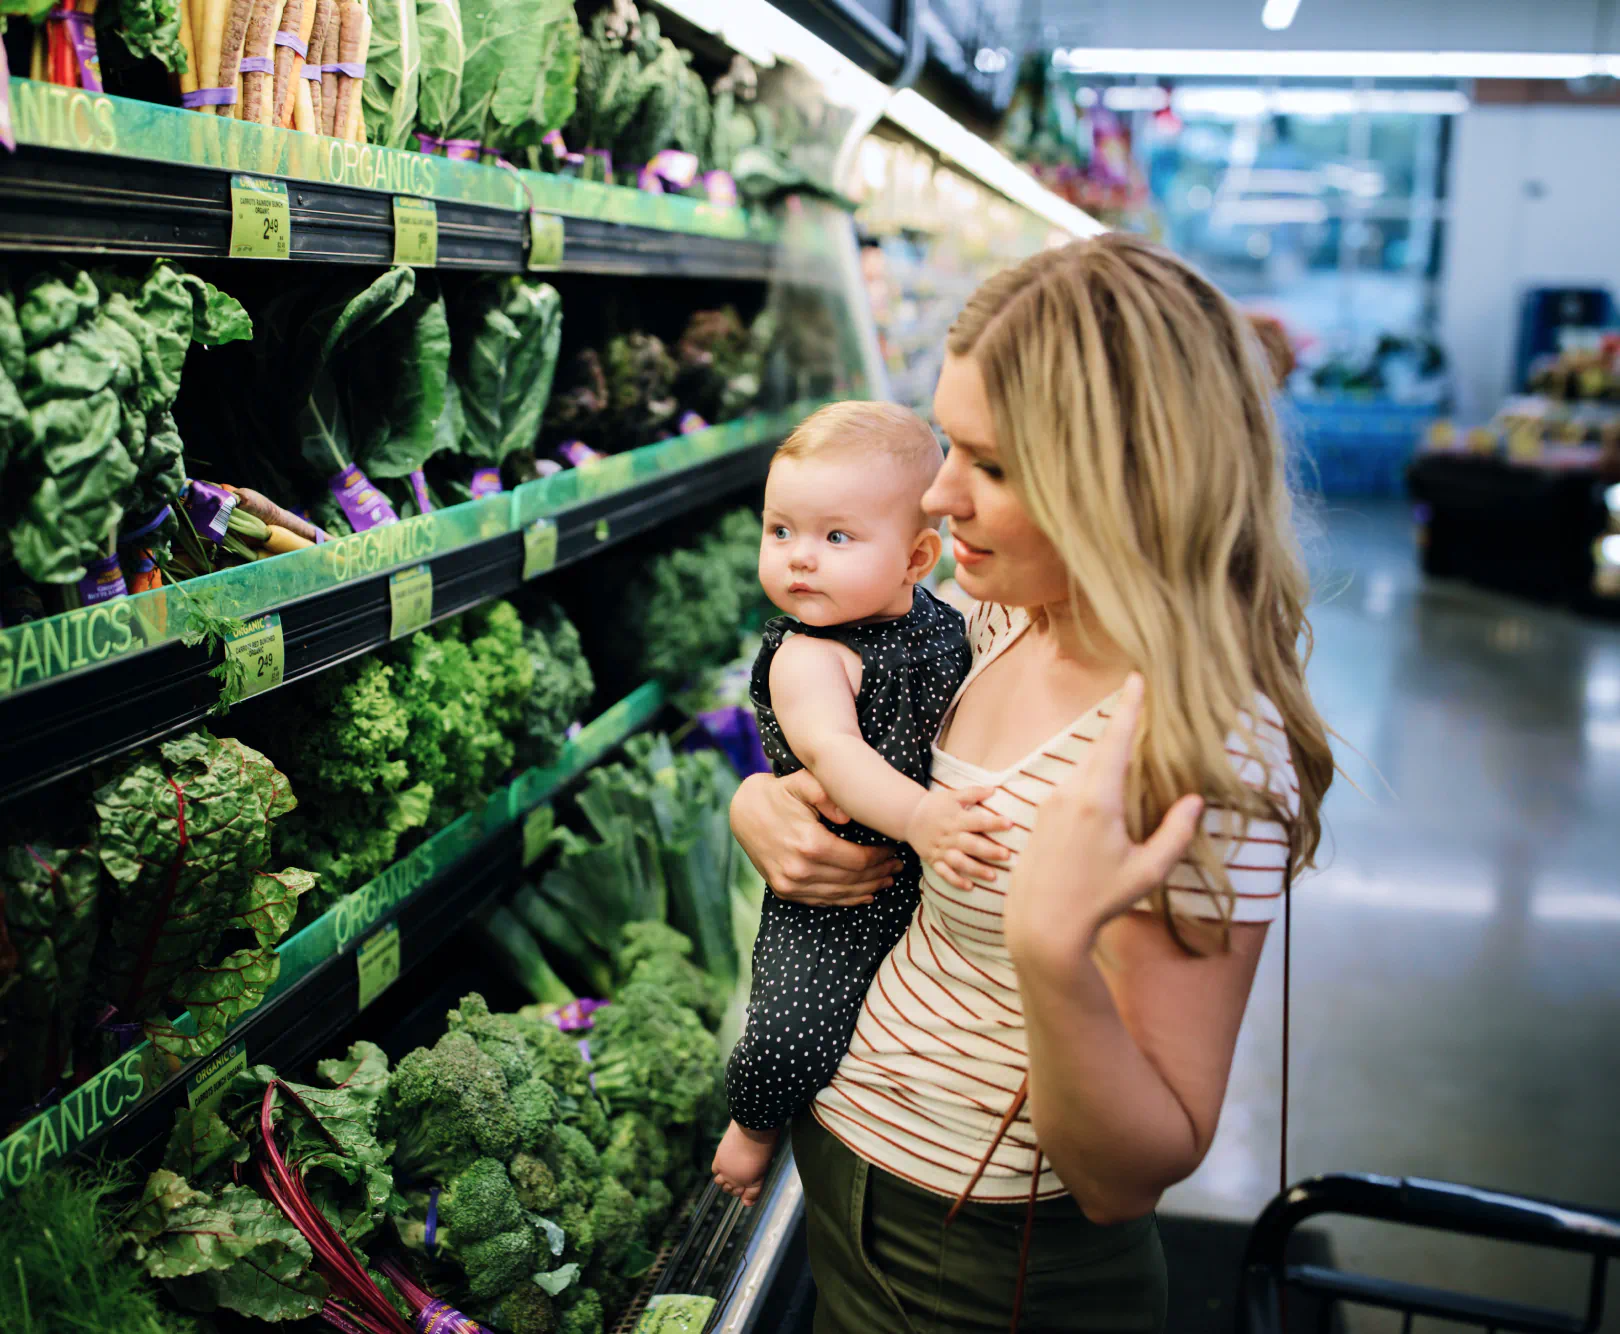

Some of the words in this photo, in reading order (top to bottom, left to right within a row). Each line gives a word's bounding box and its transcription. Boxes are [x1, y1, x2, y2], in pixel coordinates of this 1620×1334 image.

[329, 140, 435, 196] ORGANICS
[333, 516, 436, 581] ORGANICS
[335, 842, 434, 944] ORGANICS
[195, 1050, 230, 1084] ORGANIC
